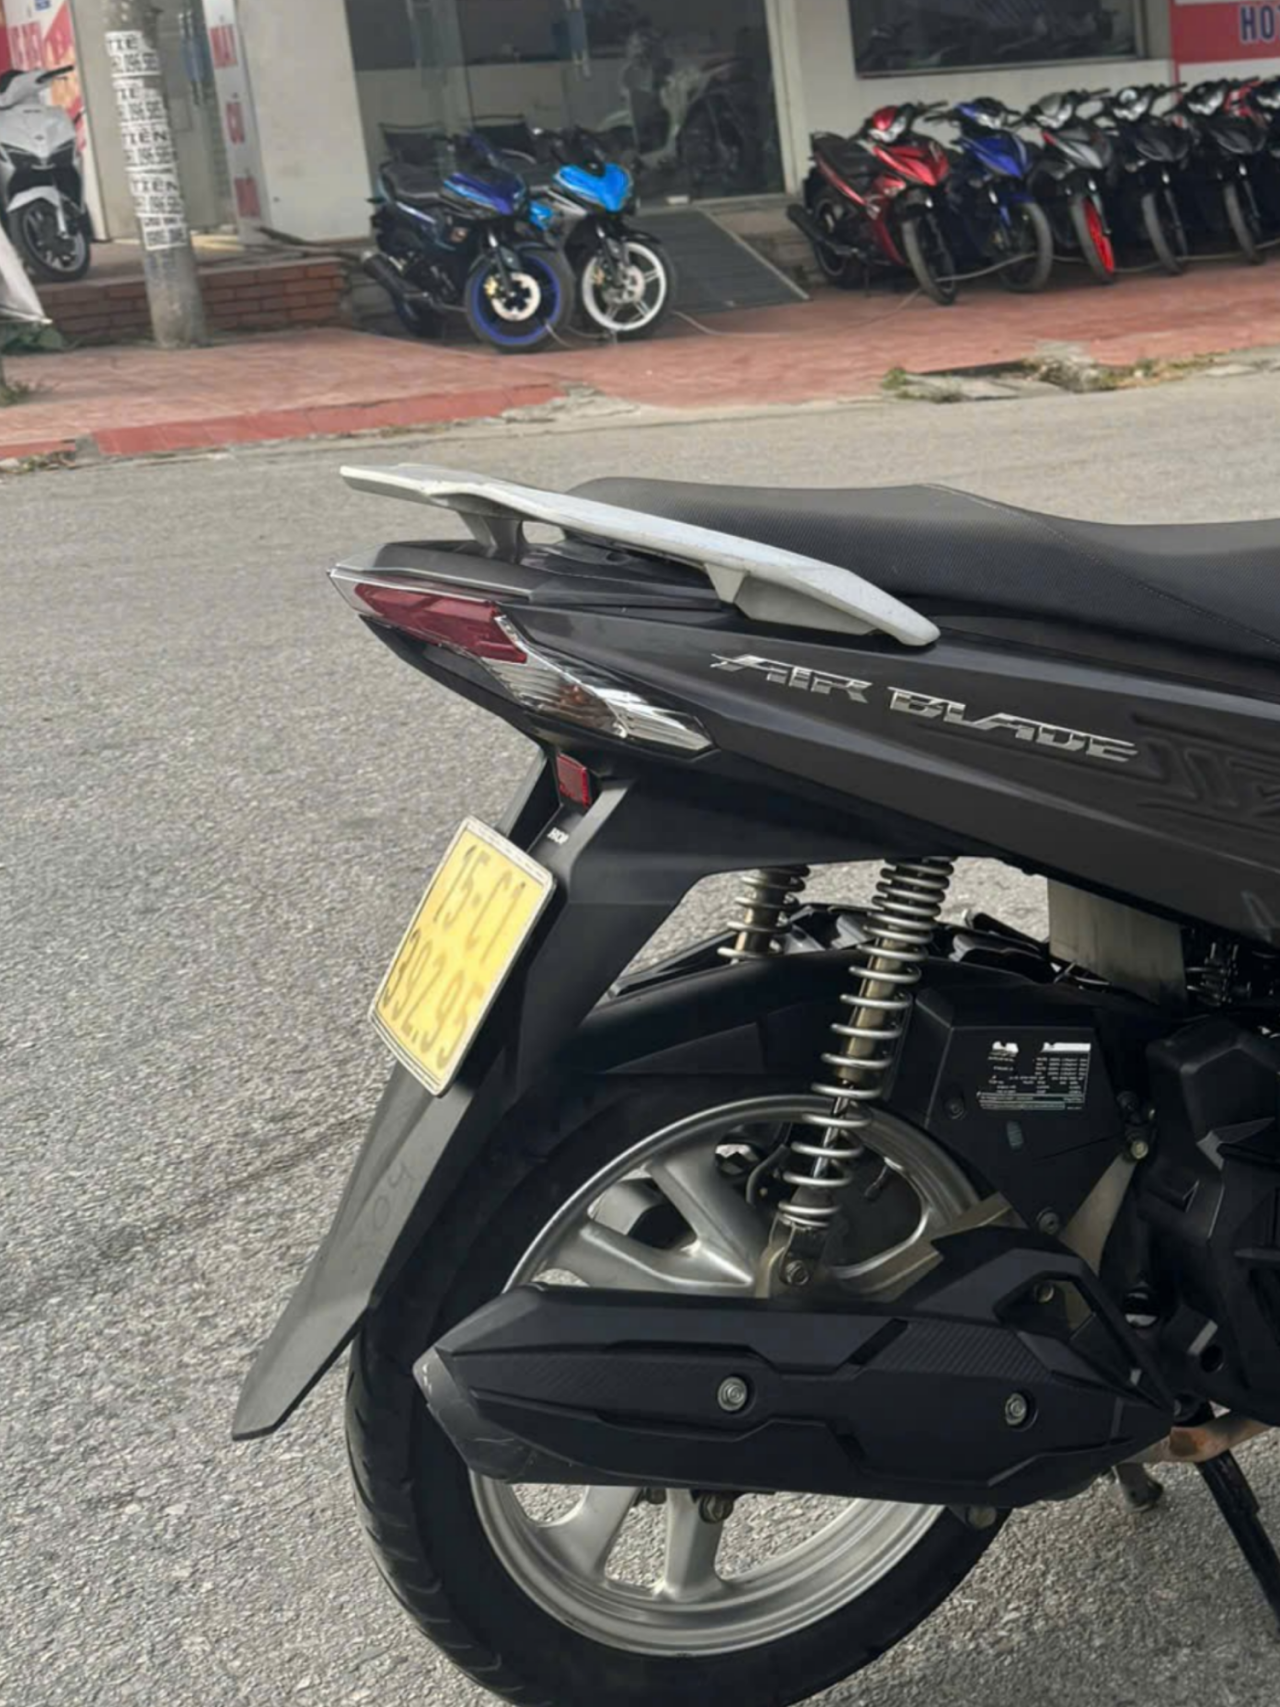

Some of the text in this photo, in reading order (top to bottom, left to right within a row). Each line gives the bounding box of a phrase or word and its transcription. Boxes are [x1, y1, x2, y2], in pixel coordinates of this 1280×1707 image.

[710, 653, 1139, 763] AIR BLADE
[432, 844, 527, 967] 15-C1
[382, 927, 485, 1070] 392.95
